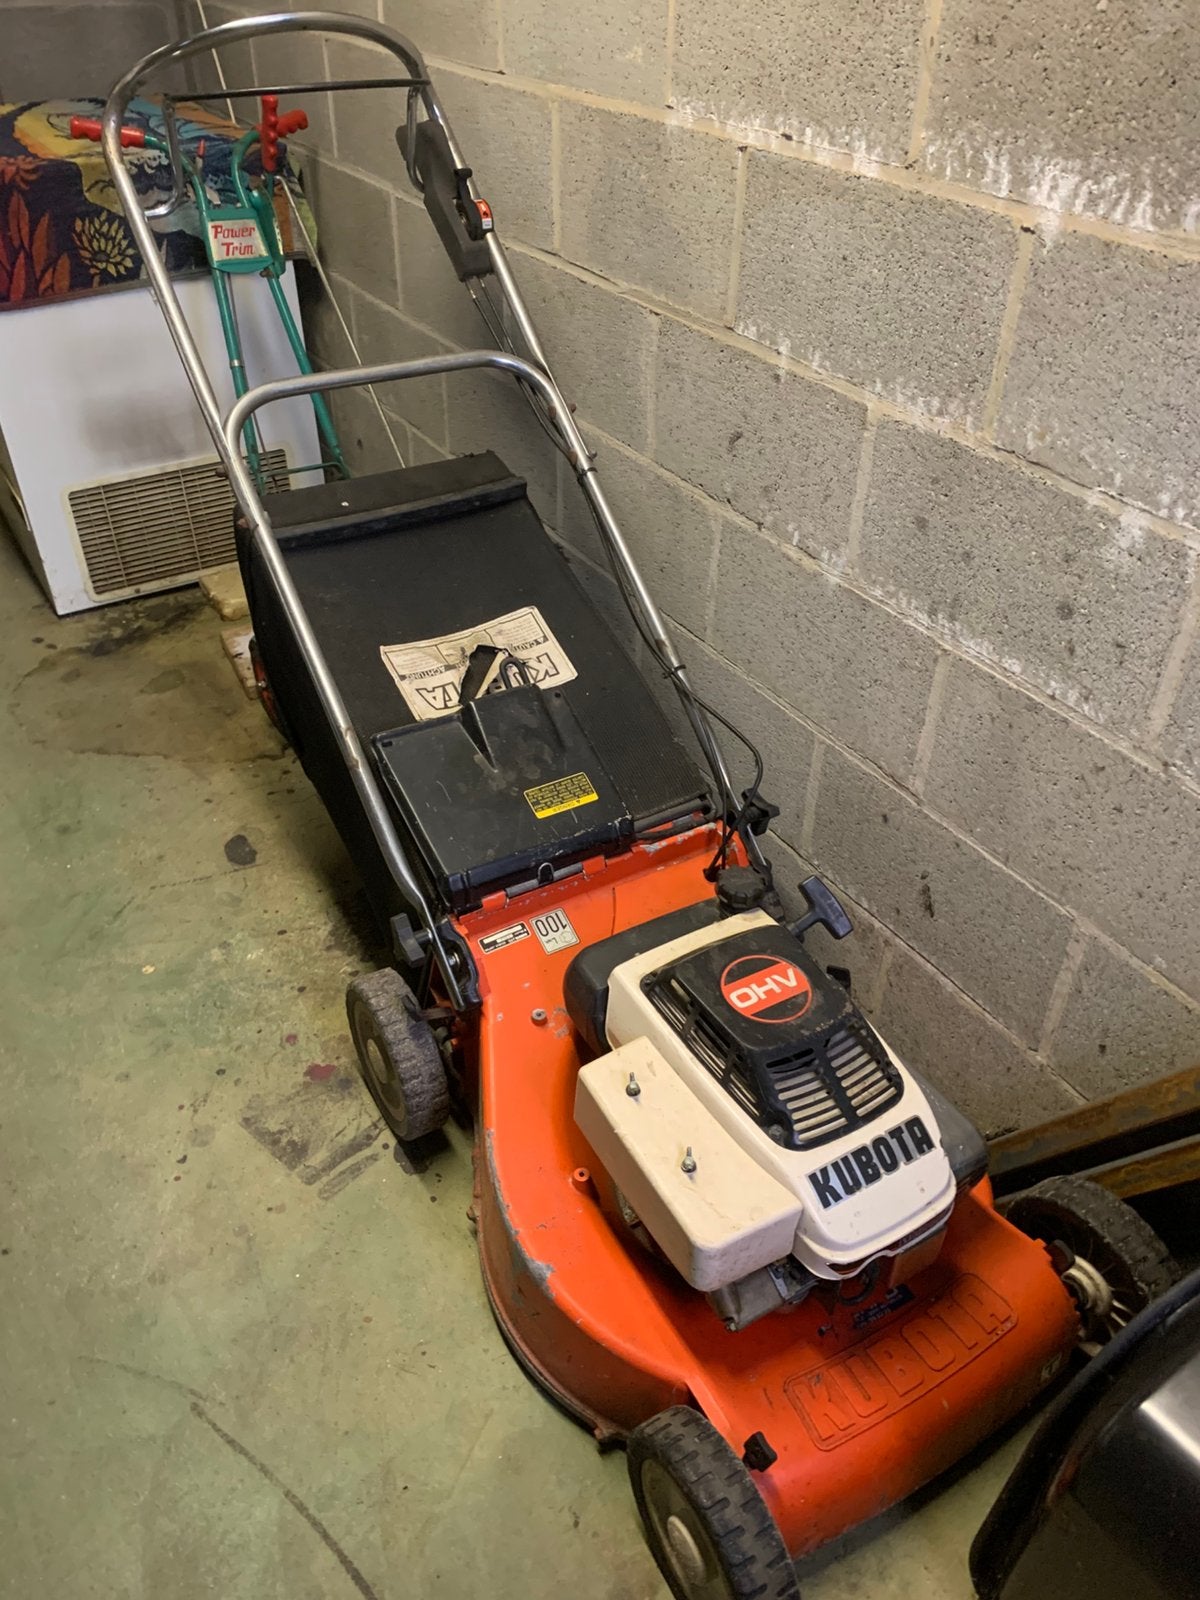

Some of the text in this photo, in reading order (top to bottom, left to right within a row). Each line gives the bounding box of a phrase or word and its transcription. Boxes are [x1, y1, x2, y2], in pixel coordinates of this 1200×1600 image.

[211, 224, 256, 239] Power
[221, 242, 254, 257] Trim
[535, 912, 567, 937] 100
[729, 967, 798, 1008] OHV
[808, 1117, 936, 1209] KUBOTA
[793, 1280, 1013, 1441] KUBOTA
